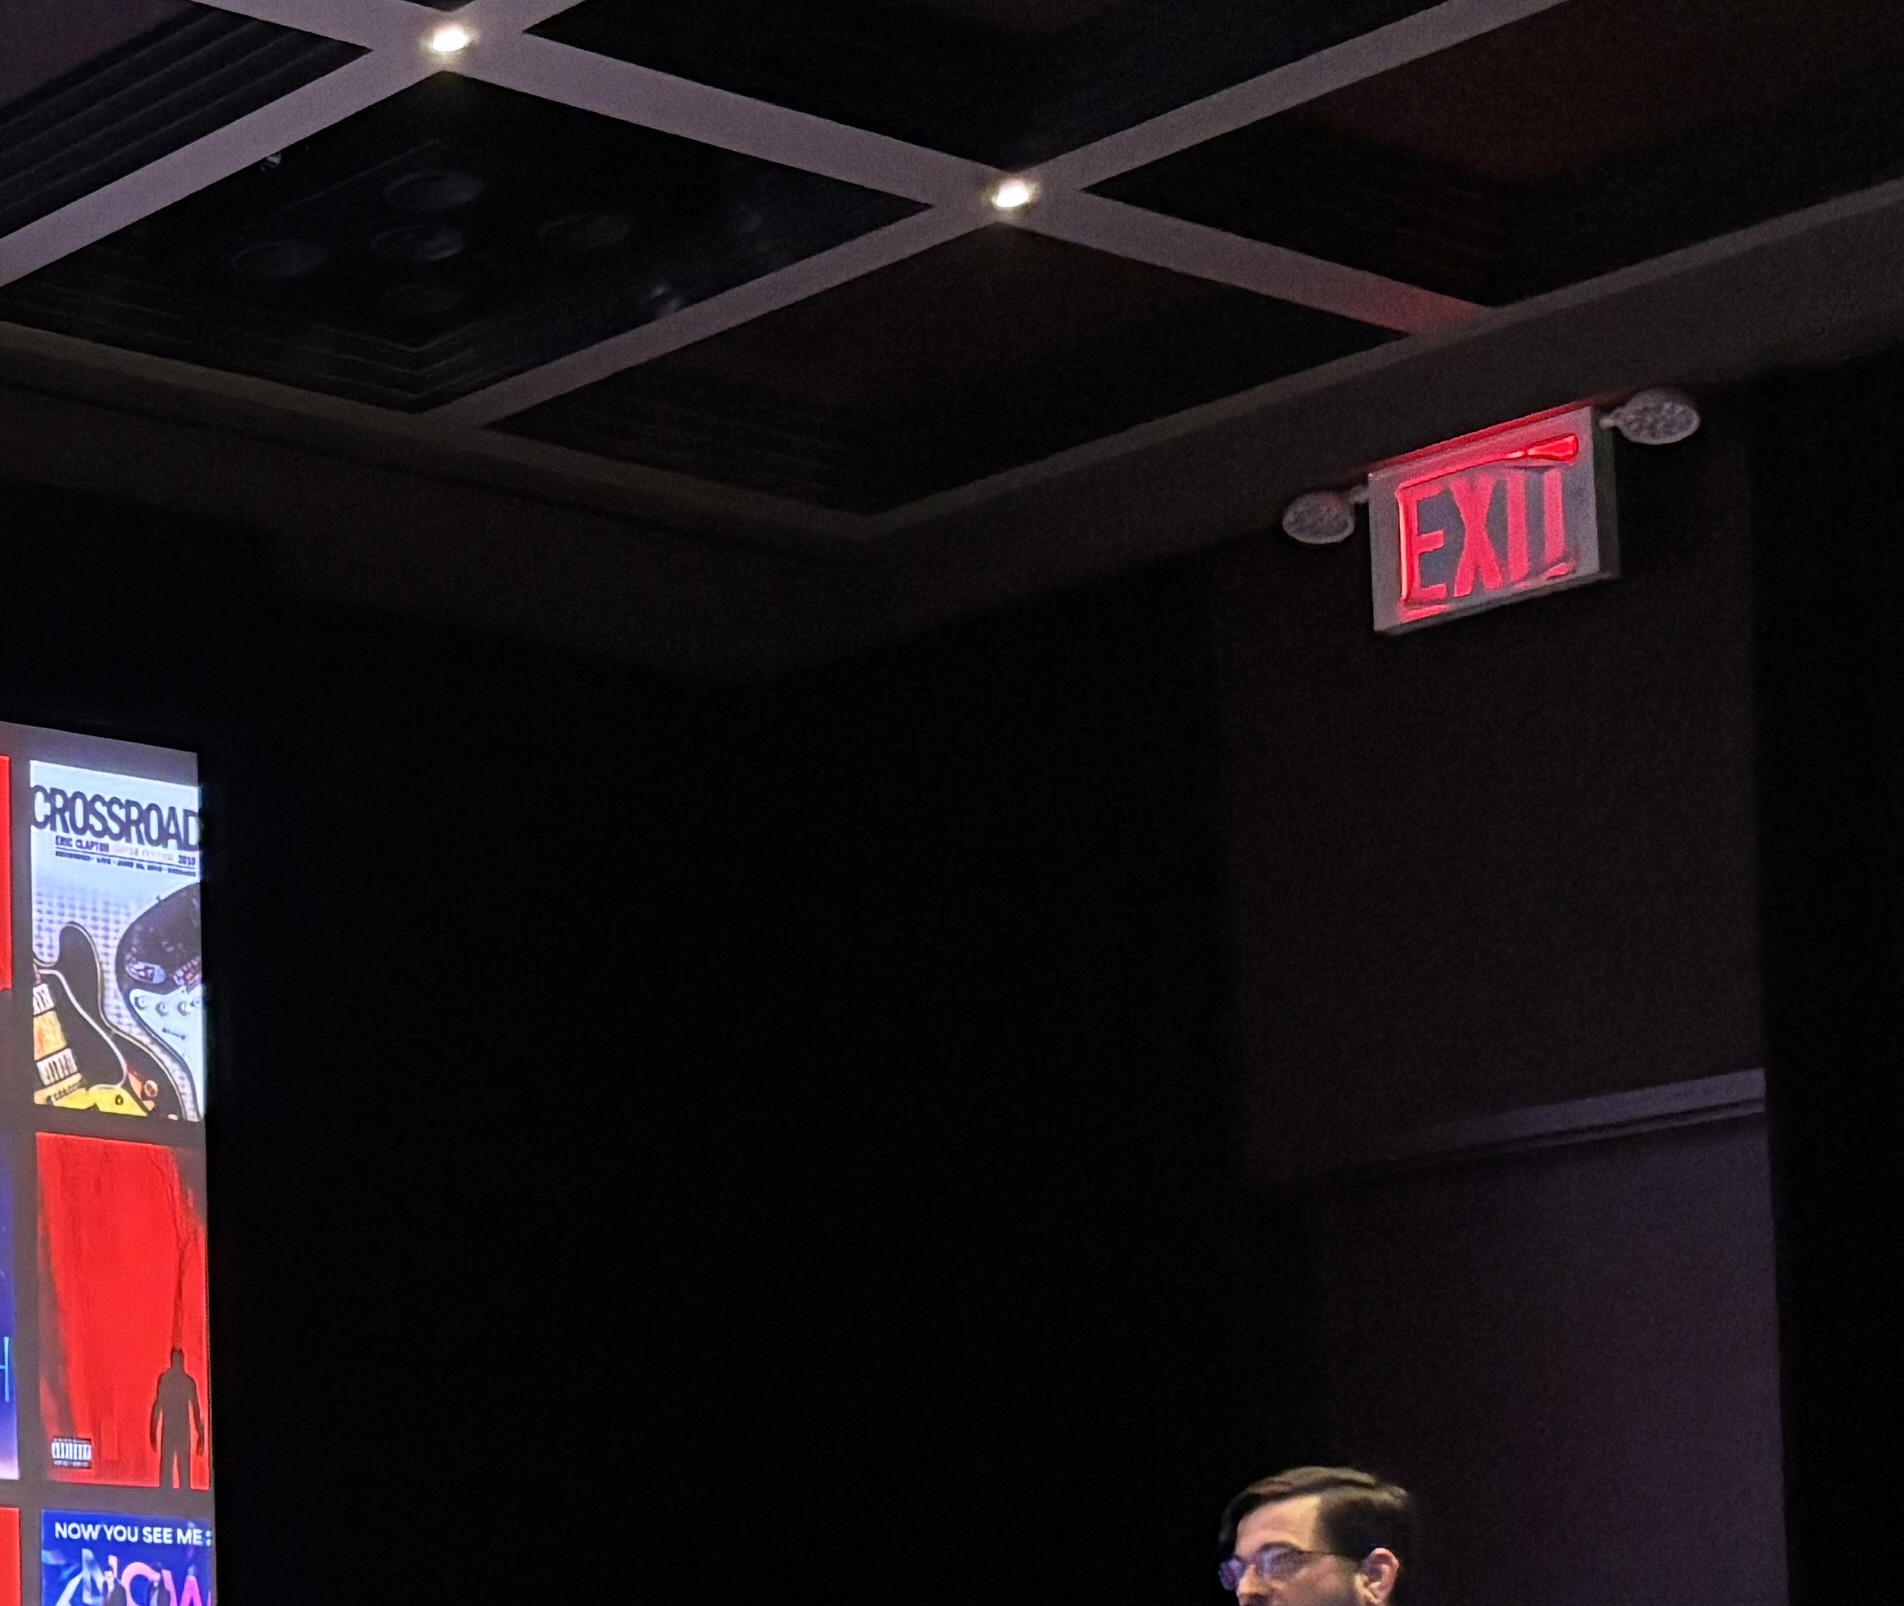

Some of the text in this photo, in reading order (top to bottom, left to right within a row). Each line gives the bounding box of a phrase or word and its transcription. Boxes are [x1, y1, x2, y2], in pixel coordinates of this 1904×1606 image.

[1398, 456, 1576, 602] EXIT
[54, 1522, 203, 1545] NOW YOU SEE ME
